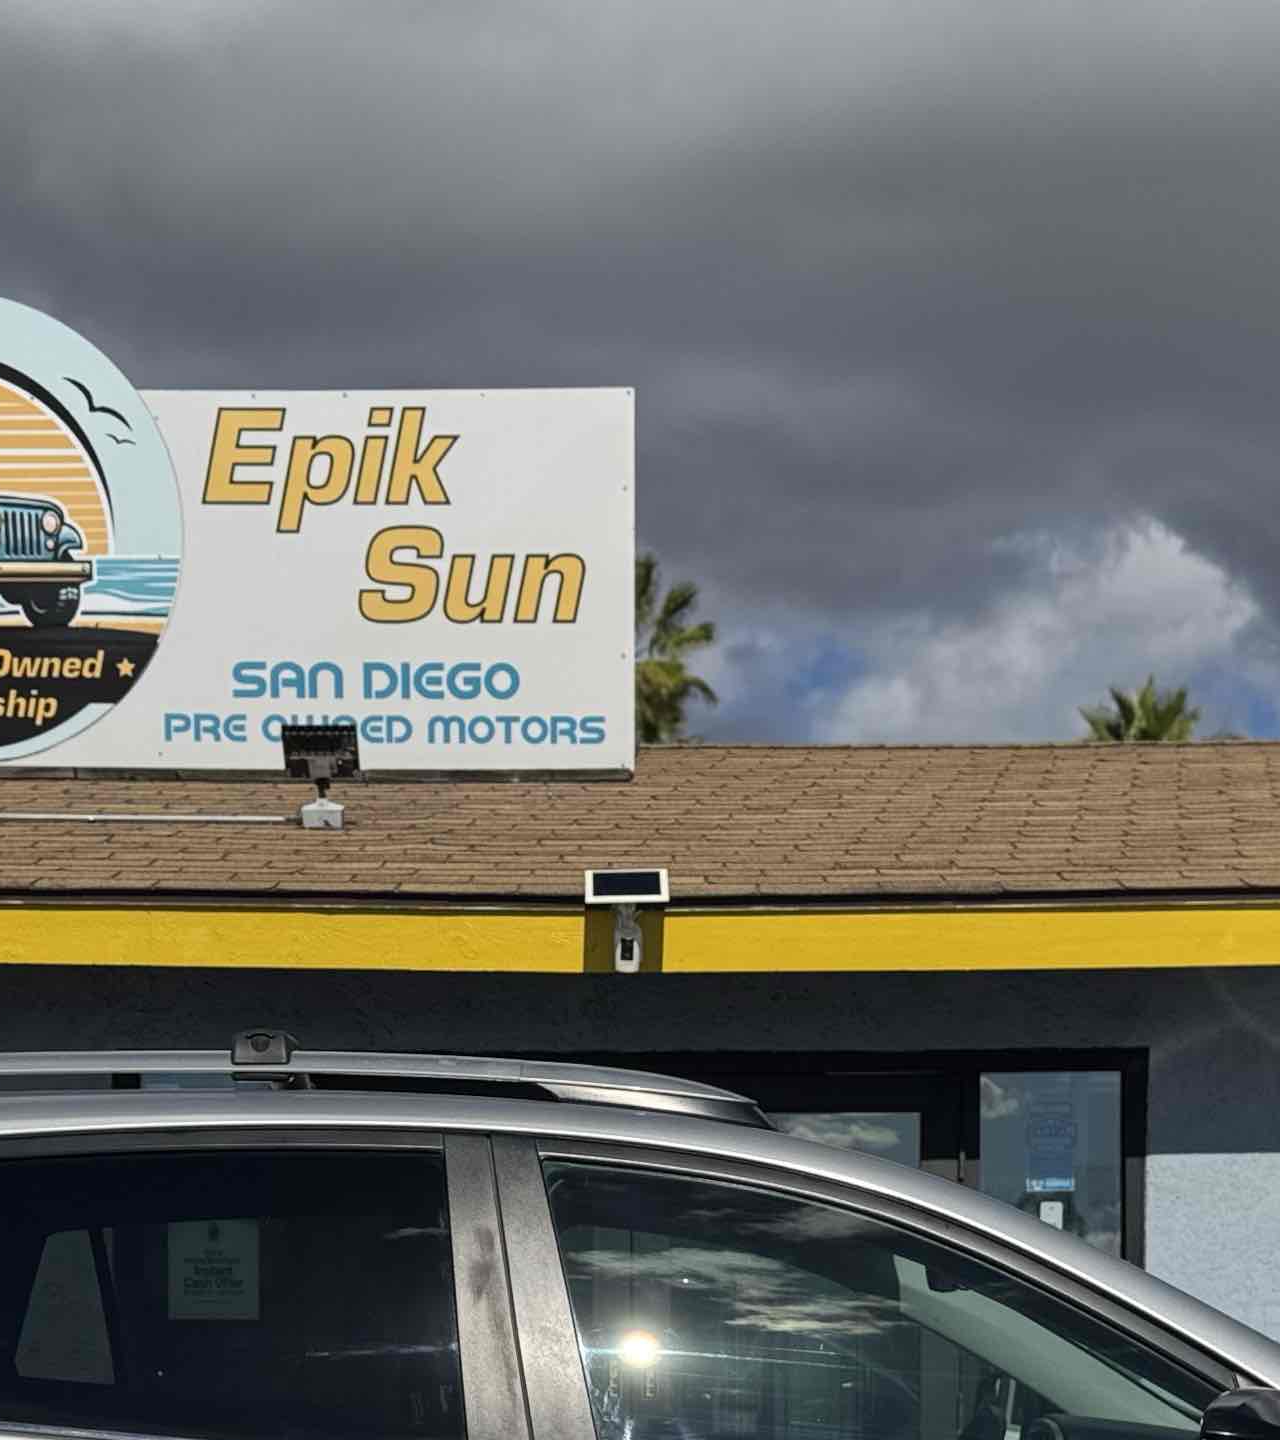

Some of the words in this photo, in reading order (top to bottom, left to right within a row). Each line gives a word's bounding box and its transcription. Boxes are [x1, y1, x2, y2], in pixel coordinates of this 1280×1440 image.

[202, 406, 460, 533] Epik
[358, 525, 586, 623] Sun
[232, 661, 344, 699] SAN
[362, 662, 521, 700] DIEGO
[163, 713, 247, 742] PRE
[428, 715, 606, 744] MOTORS
